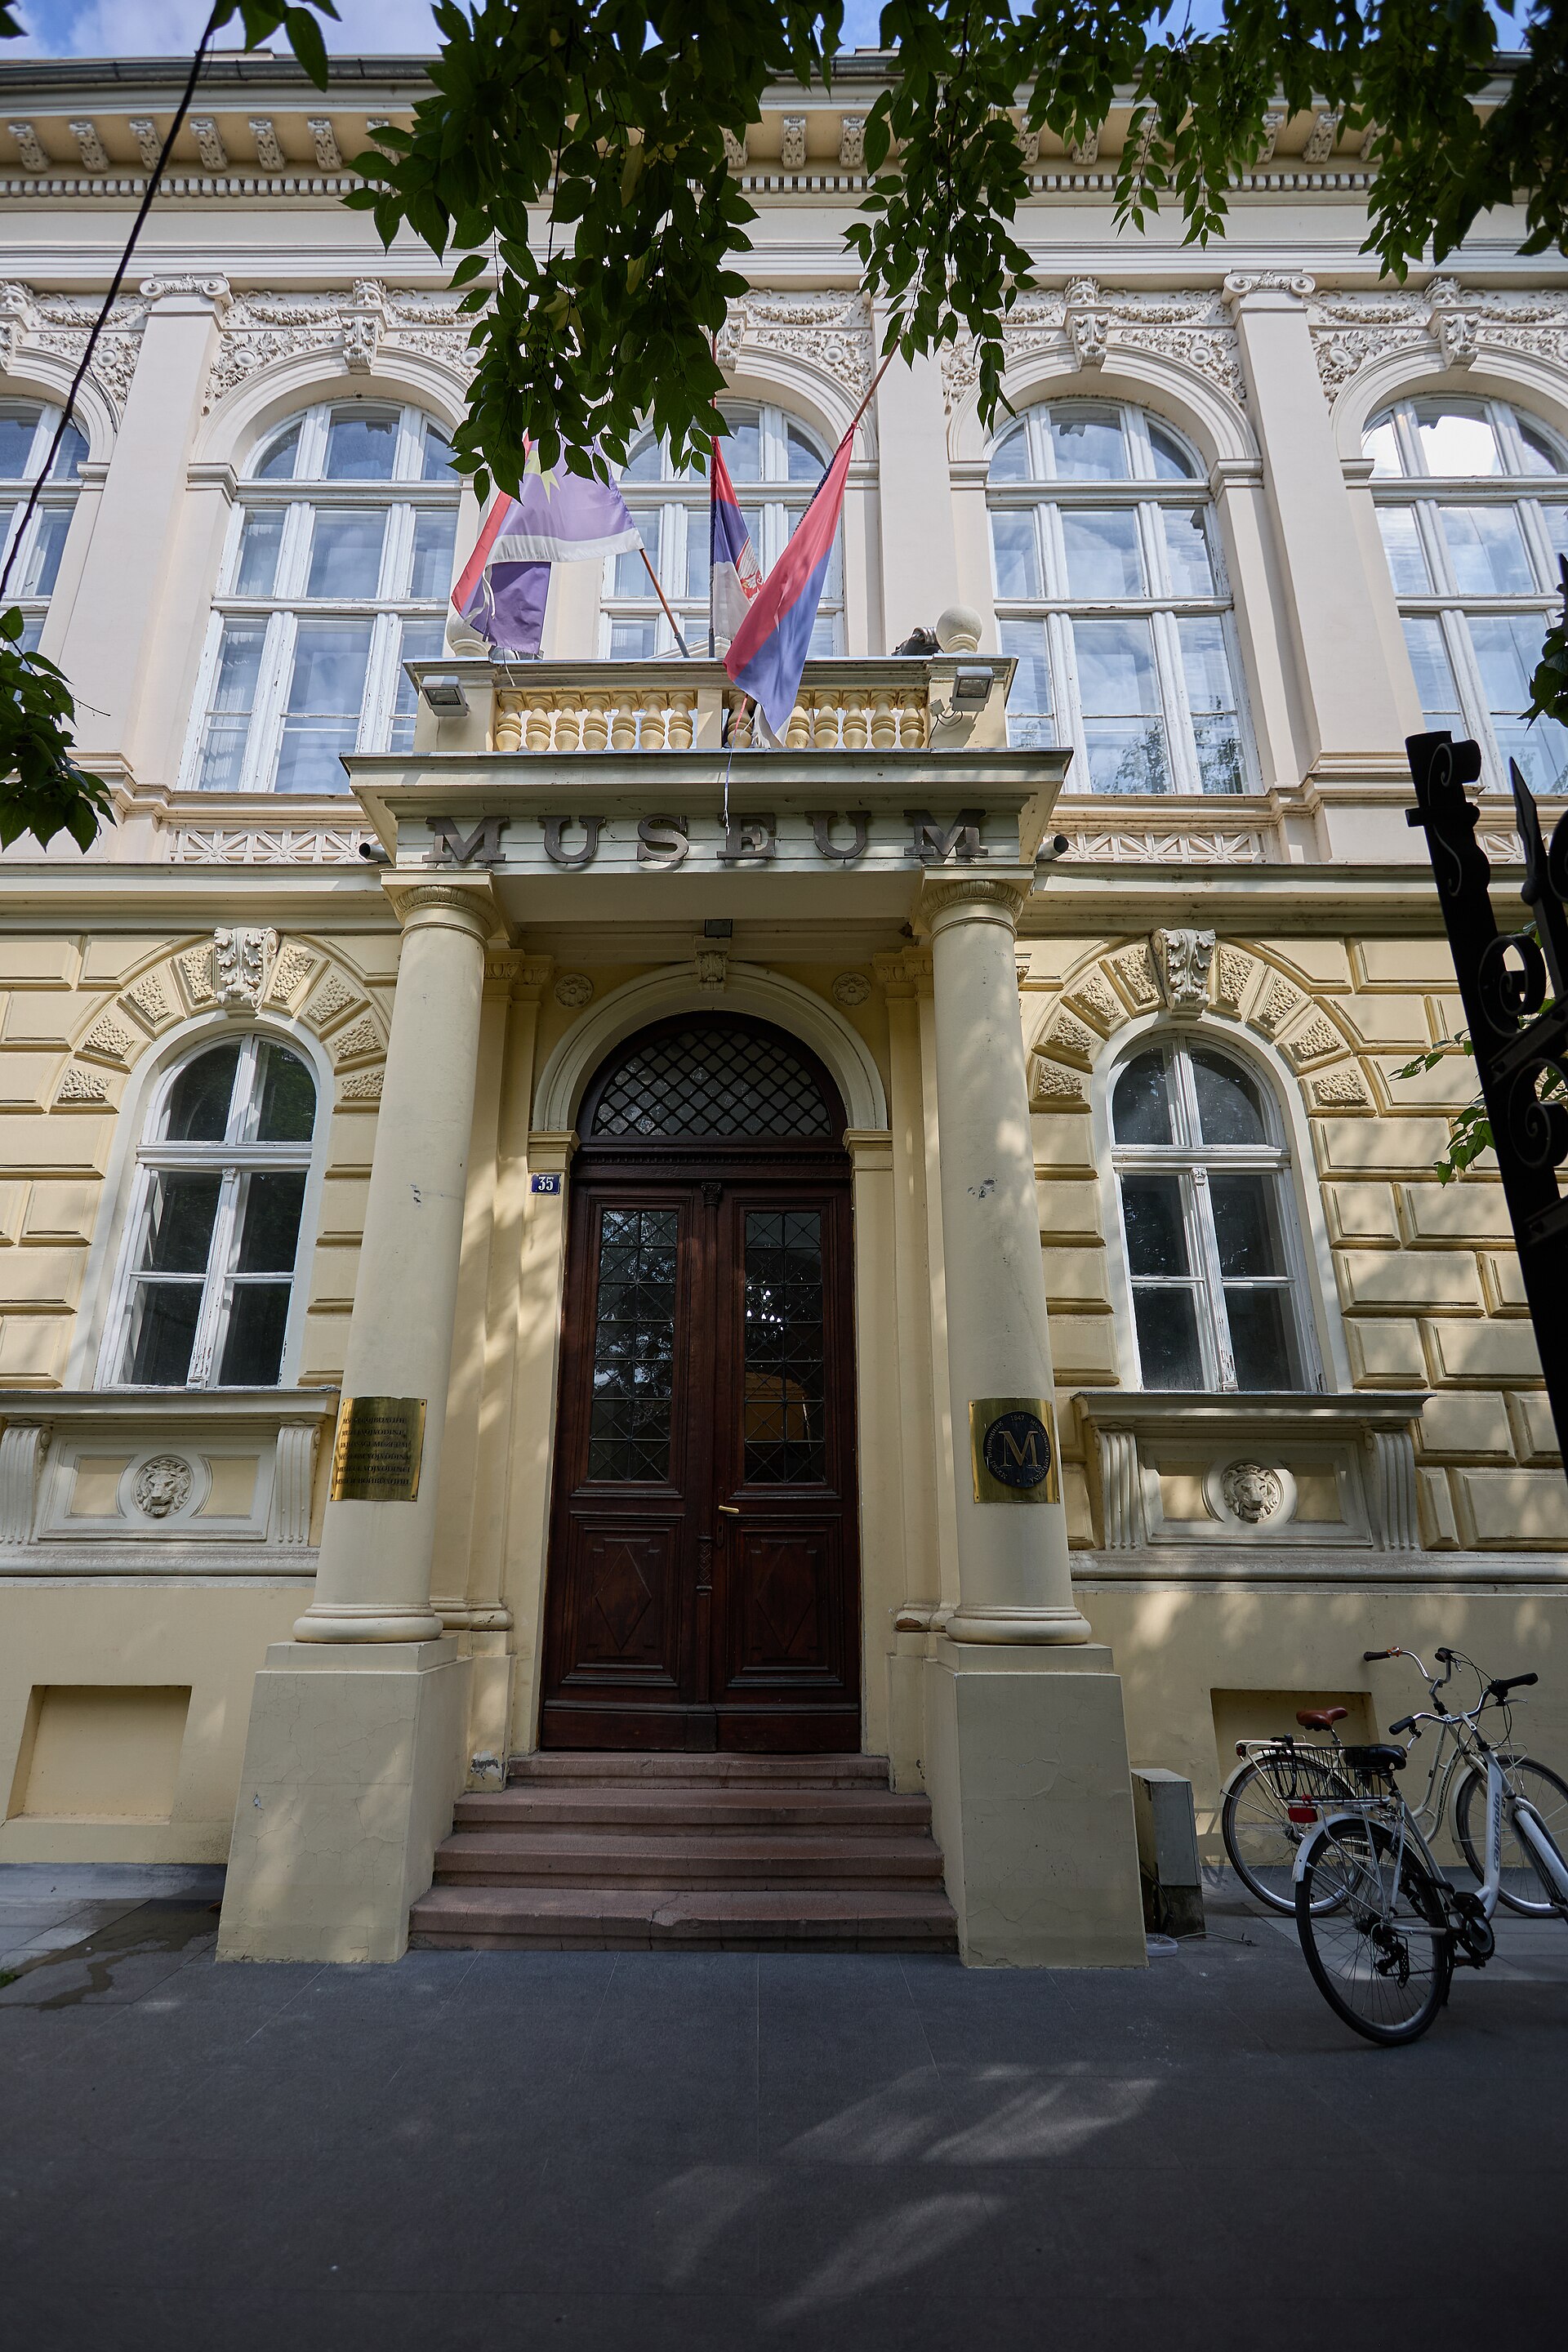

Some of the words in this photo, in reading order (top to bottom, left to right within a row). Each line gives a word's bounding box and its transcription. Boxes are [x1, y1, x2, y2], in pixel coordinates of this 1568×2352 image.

[422, 808, 988, 863] MUSEUM
[541, 1179, 554, 1191] 35
[998, 1431, 1042, 1468] M
